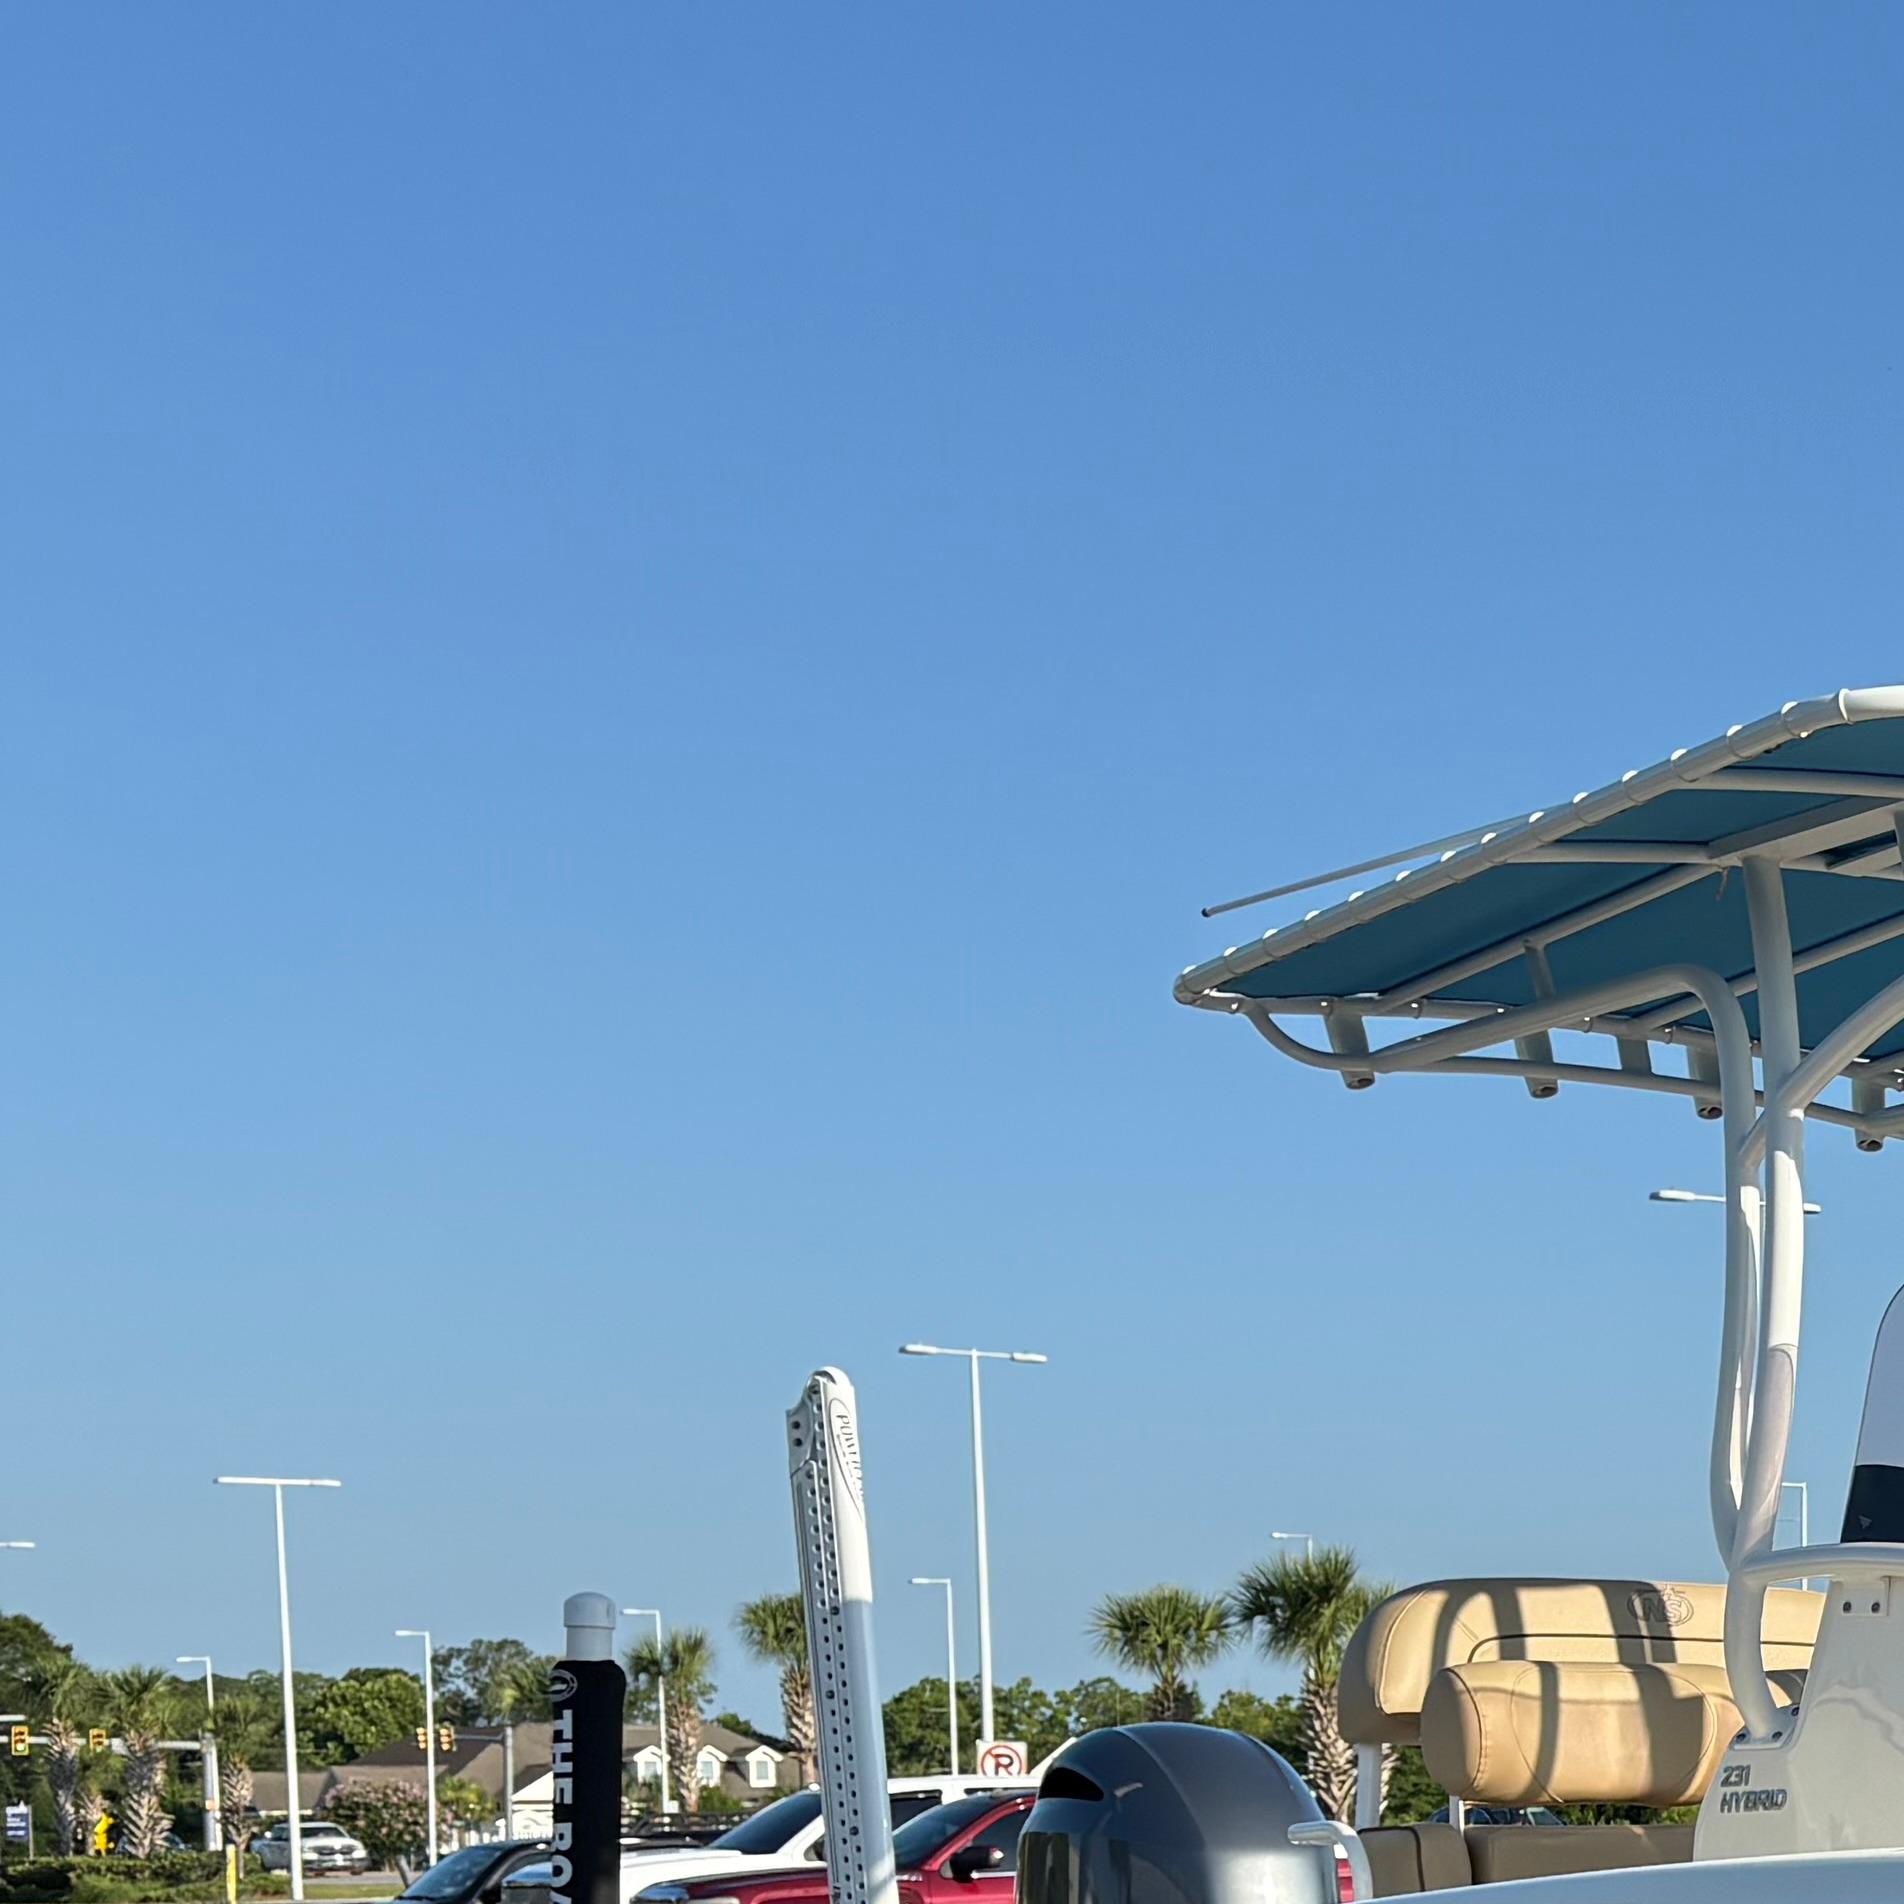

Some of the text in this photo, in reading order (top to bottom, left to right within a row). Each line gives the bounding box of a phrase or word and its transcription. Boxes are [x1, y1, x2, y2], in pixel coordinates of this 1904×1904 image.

[553, 1709, 574, 1805] THE
[1720, 1765, 1751, 1788] 231
[1720, 1789, 1788, 1814] HYBRID
